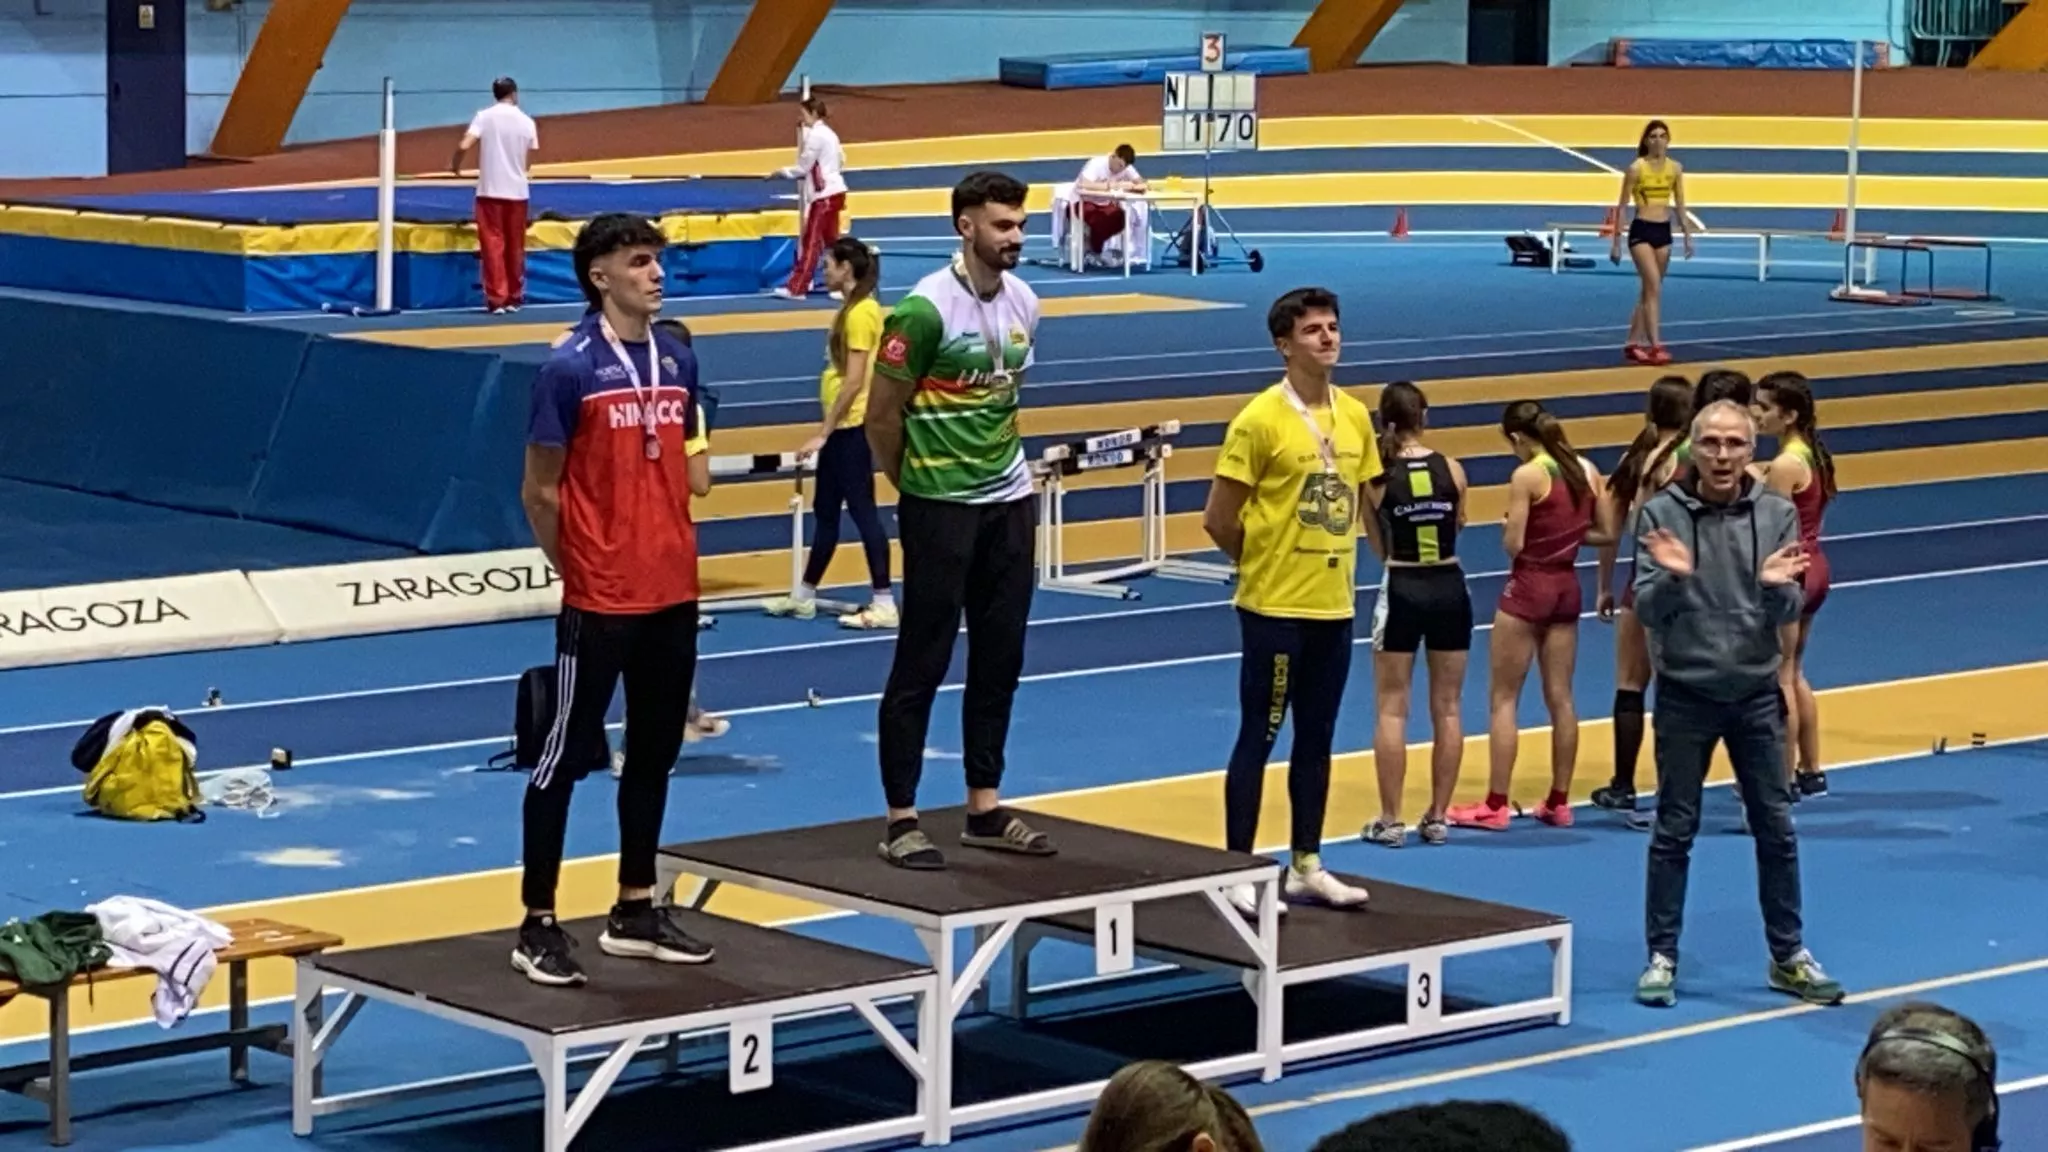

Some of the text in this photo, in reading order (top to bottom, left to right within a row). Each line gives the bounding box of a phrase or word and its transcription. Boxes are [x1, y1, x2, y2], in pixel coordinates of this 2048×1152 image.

[1204, 33, 1221, 63] 3
[1166, 75, 1179, 108] N
[1109, 917, 1117, 956] 1
[1417, 971, 1431, 1009] 3
[742, 1033, 760, 1075] 2
